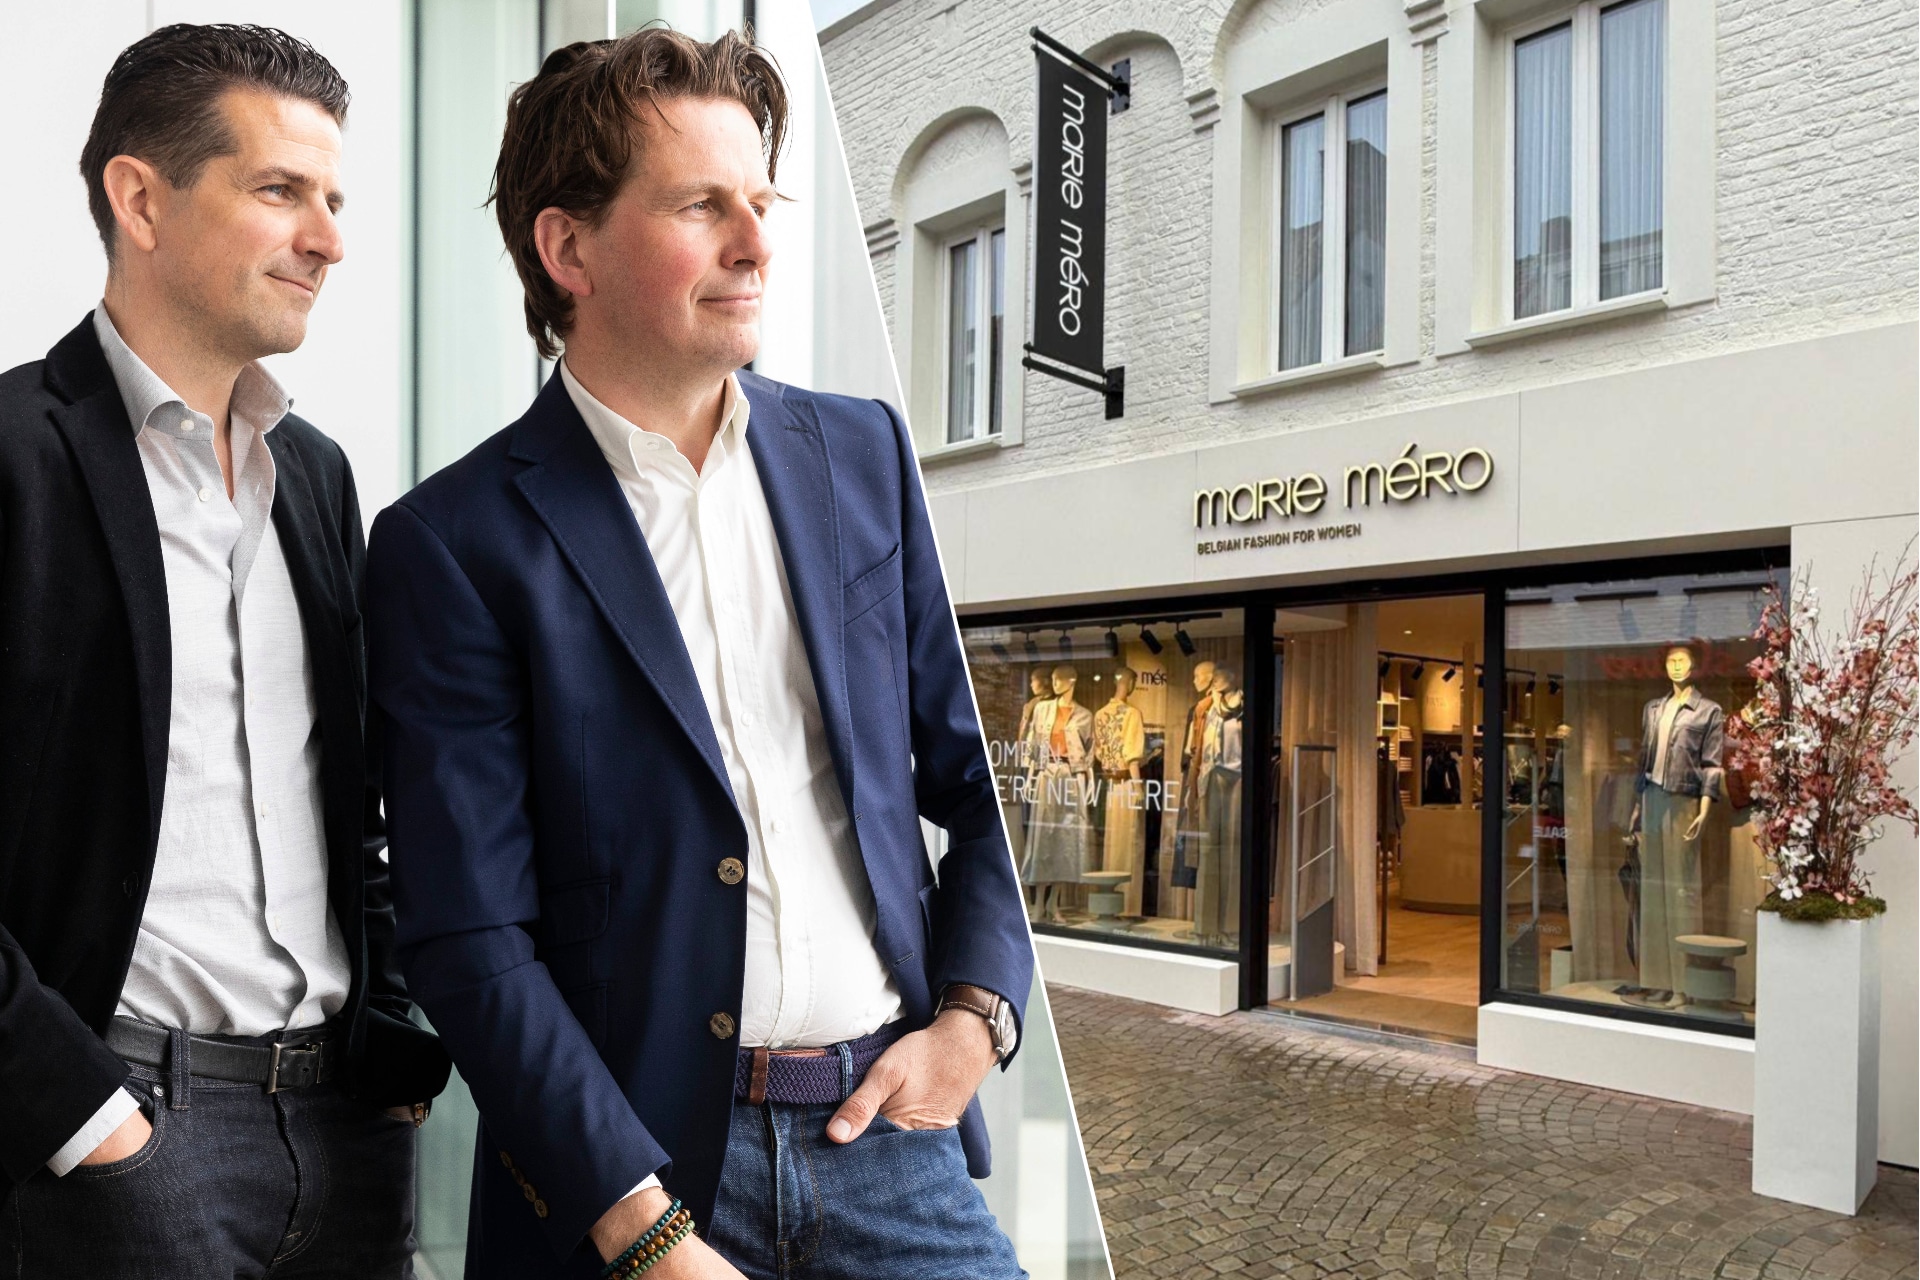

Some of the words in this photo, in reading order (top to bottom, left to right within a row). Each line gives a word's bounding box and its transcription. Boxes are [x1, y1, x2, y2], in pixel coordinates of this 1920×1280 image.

[1197, 536, 1241, 556] BELGIAN
[1243, 532, 1290, 551] FASHION
[1293, 529, 1315, 544] FOR
[1317, 522, 1362, 540] WOMEN
[1047, 776, 1102, 807] NEW
[1107, 777, 1181, 813] HERE
